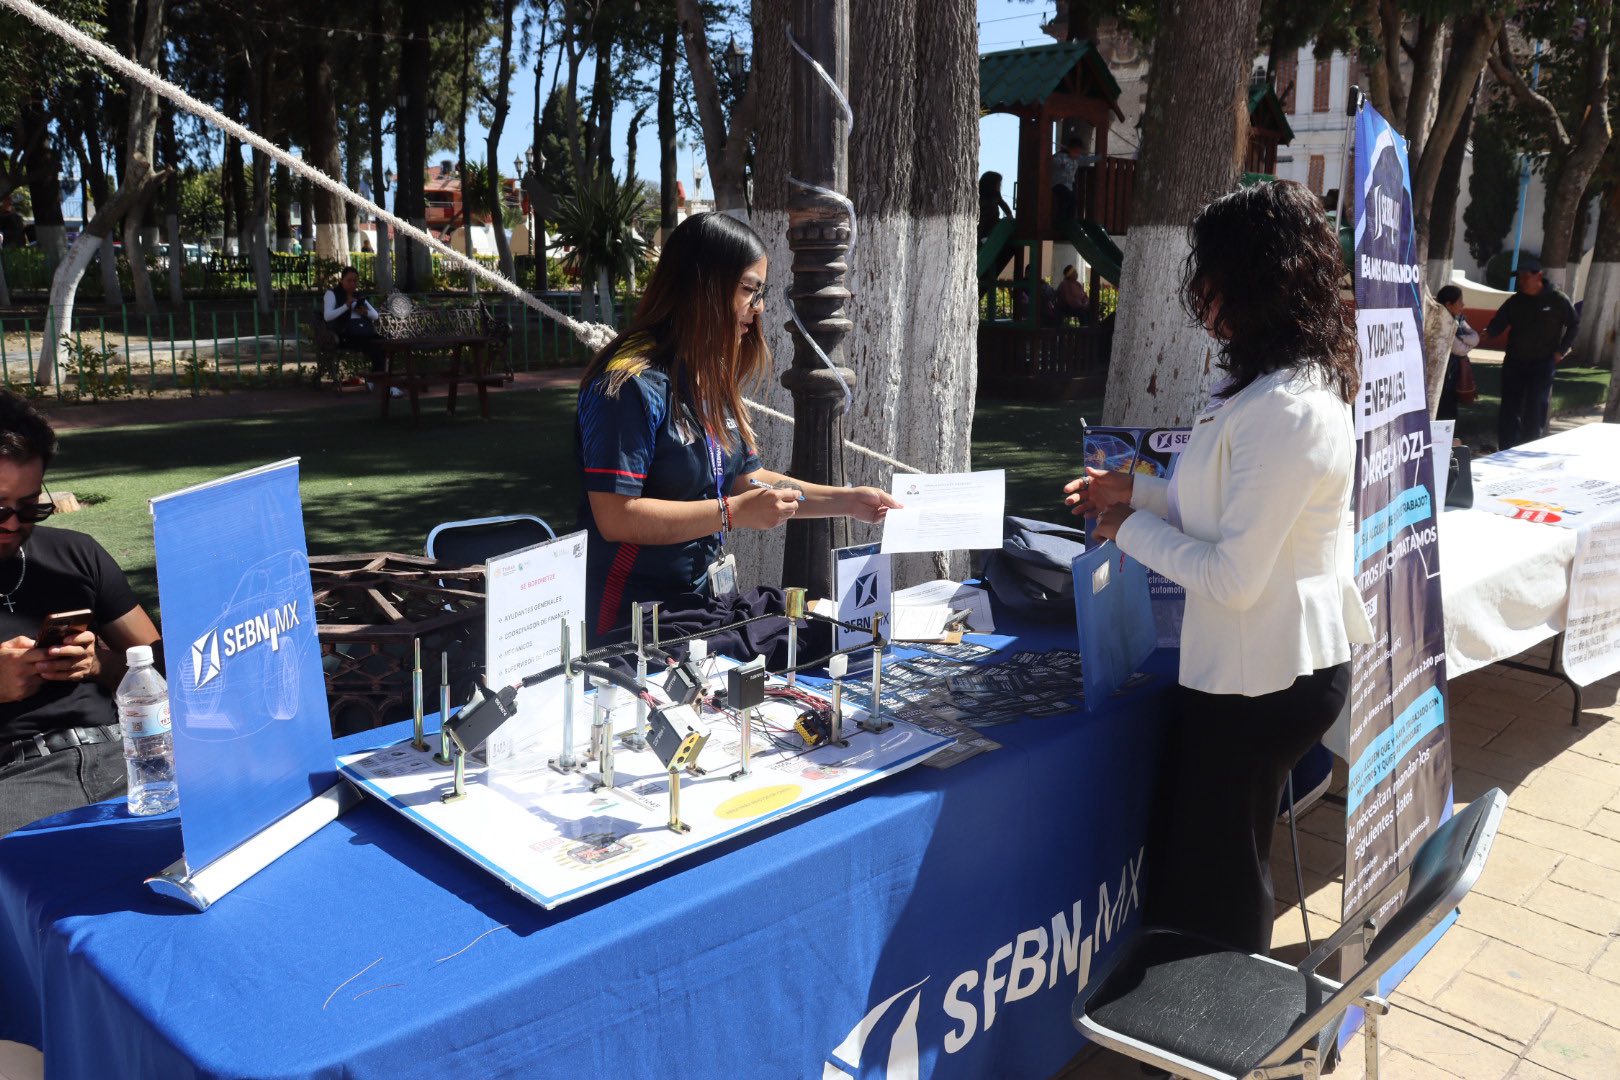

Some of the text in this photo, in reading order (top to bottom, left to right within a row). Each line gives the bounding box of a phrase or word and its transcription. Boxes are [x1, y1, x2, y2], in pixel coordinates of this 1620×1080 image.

[1366, 321, 1405, 359] YUDANTES
[223, 600, 300, 657] SEBN MX
[1356, 786, 1392, 833] necesitan
[1393, 760, 1419, 795] mandar
[1418, 748, 1430, 767] los
[1355, 809, 1394, 860] siguientes
[1396, 788, 1413, 817] datos
